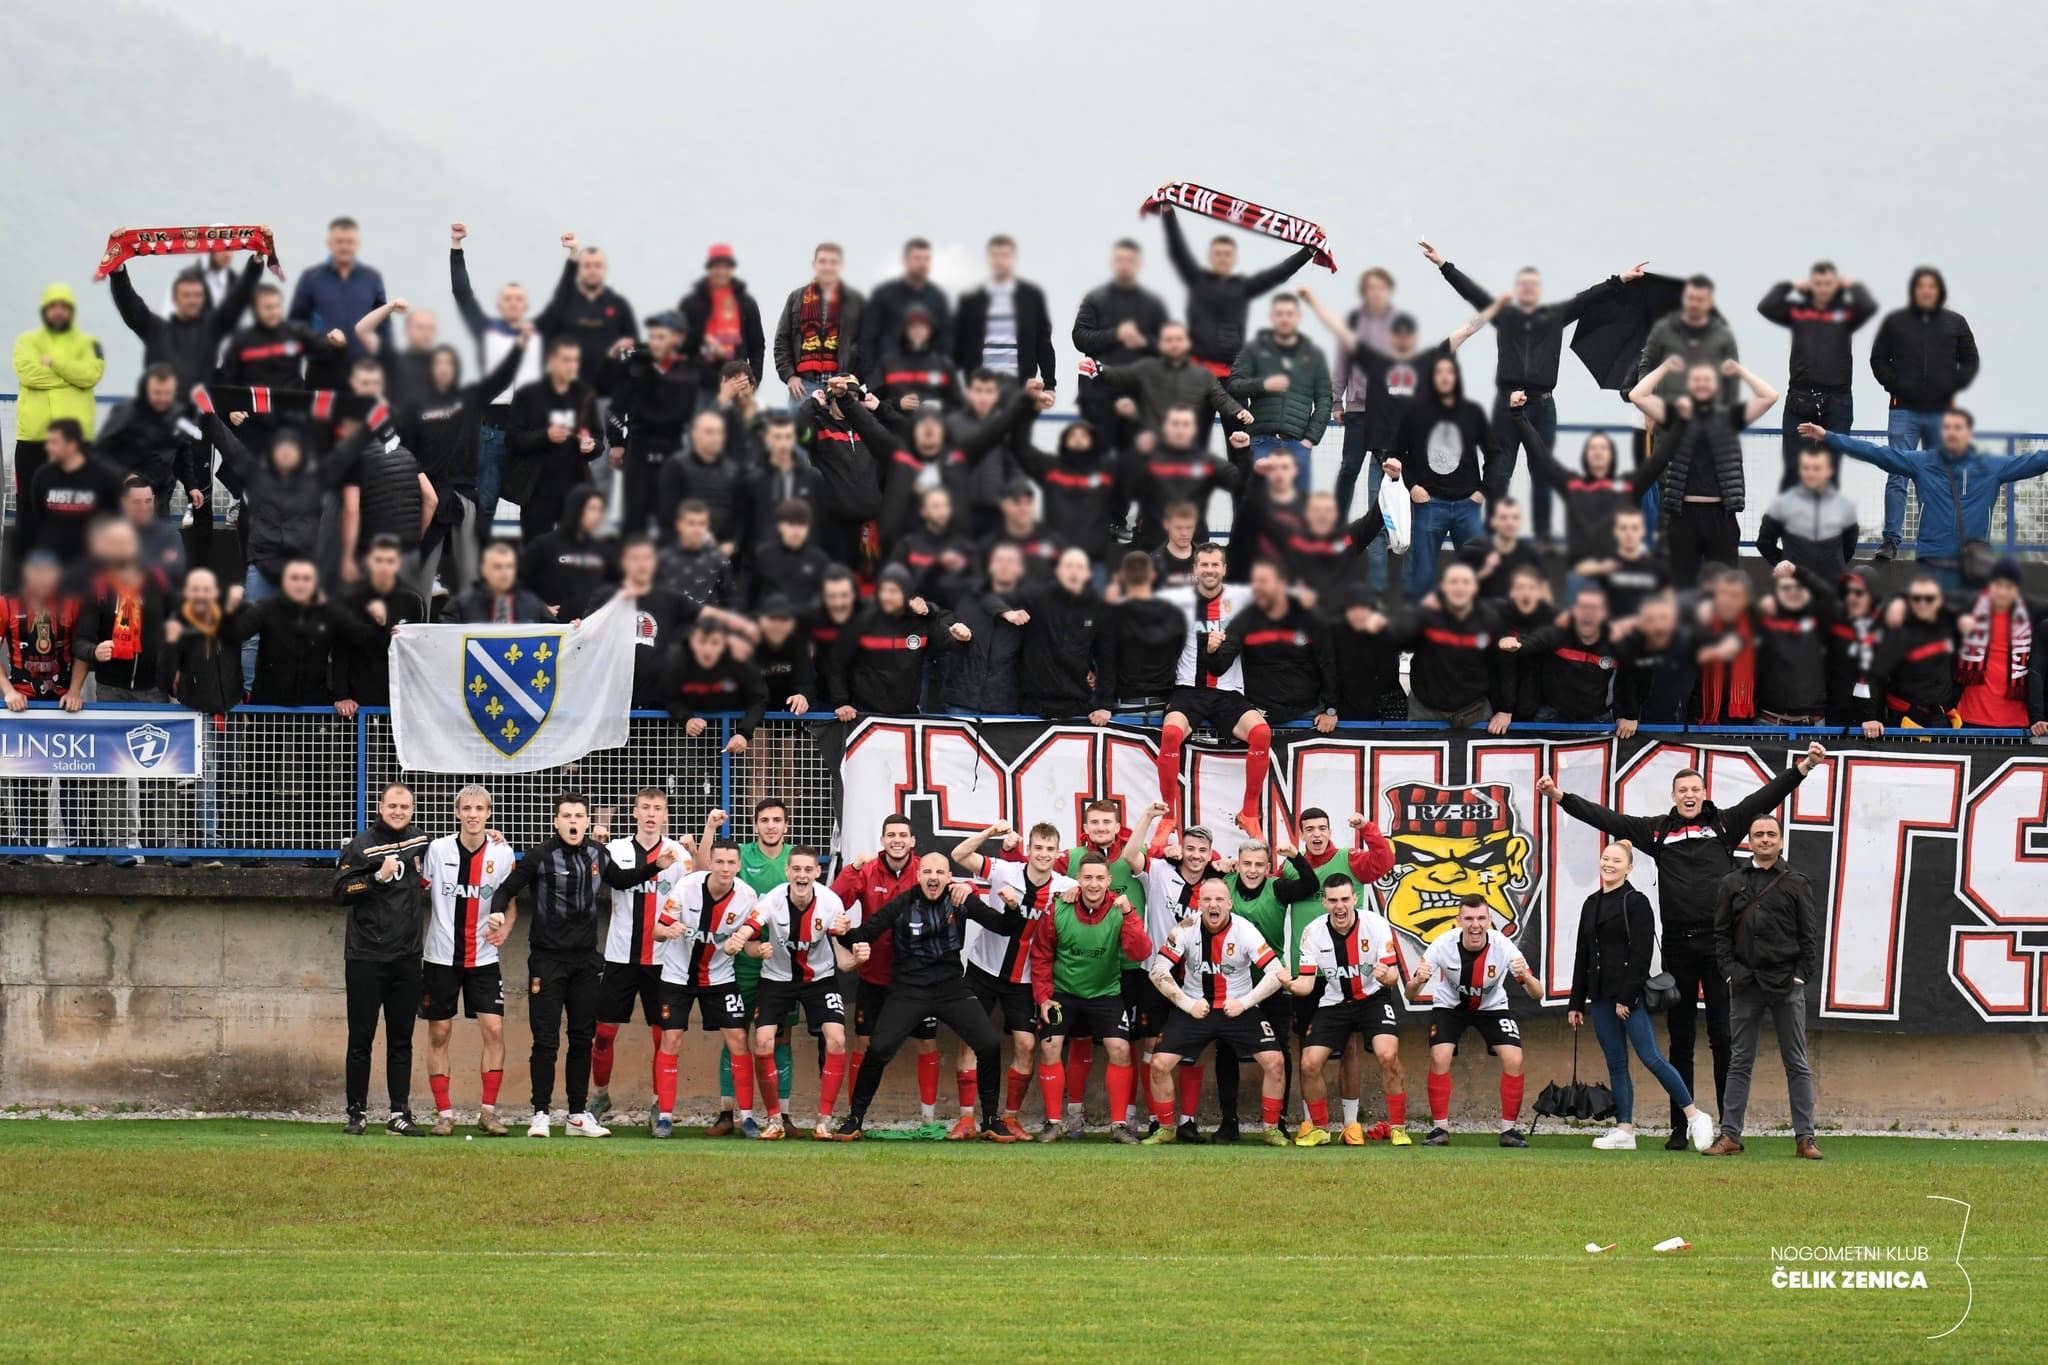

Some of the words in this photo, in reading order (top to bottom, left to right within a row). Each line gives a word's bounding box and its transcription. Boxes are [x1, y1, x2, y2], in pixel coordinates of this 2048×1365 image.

[1193, 620, 1220, 634] AN
[53, 760, 96, 771] stadion
[1415, 805, 1493, 819] RZ-88
[441, 881, 479, 899] PAN
[630, 880, 657, 894] AN
[1019, 905, 1042, 921] AN
[1322, 964, 1361, 981] PAN
[725, 993, 745, 1013] 24
[1383, 1003, 1396, 1020] 8
[1120, 1009, 1130, 1027] 4
[1259, 1020, 1275, 1037] 6
